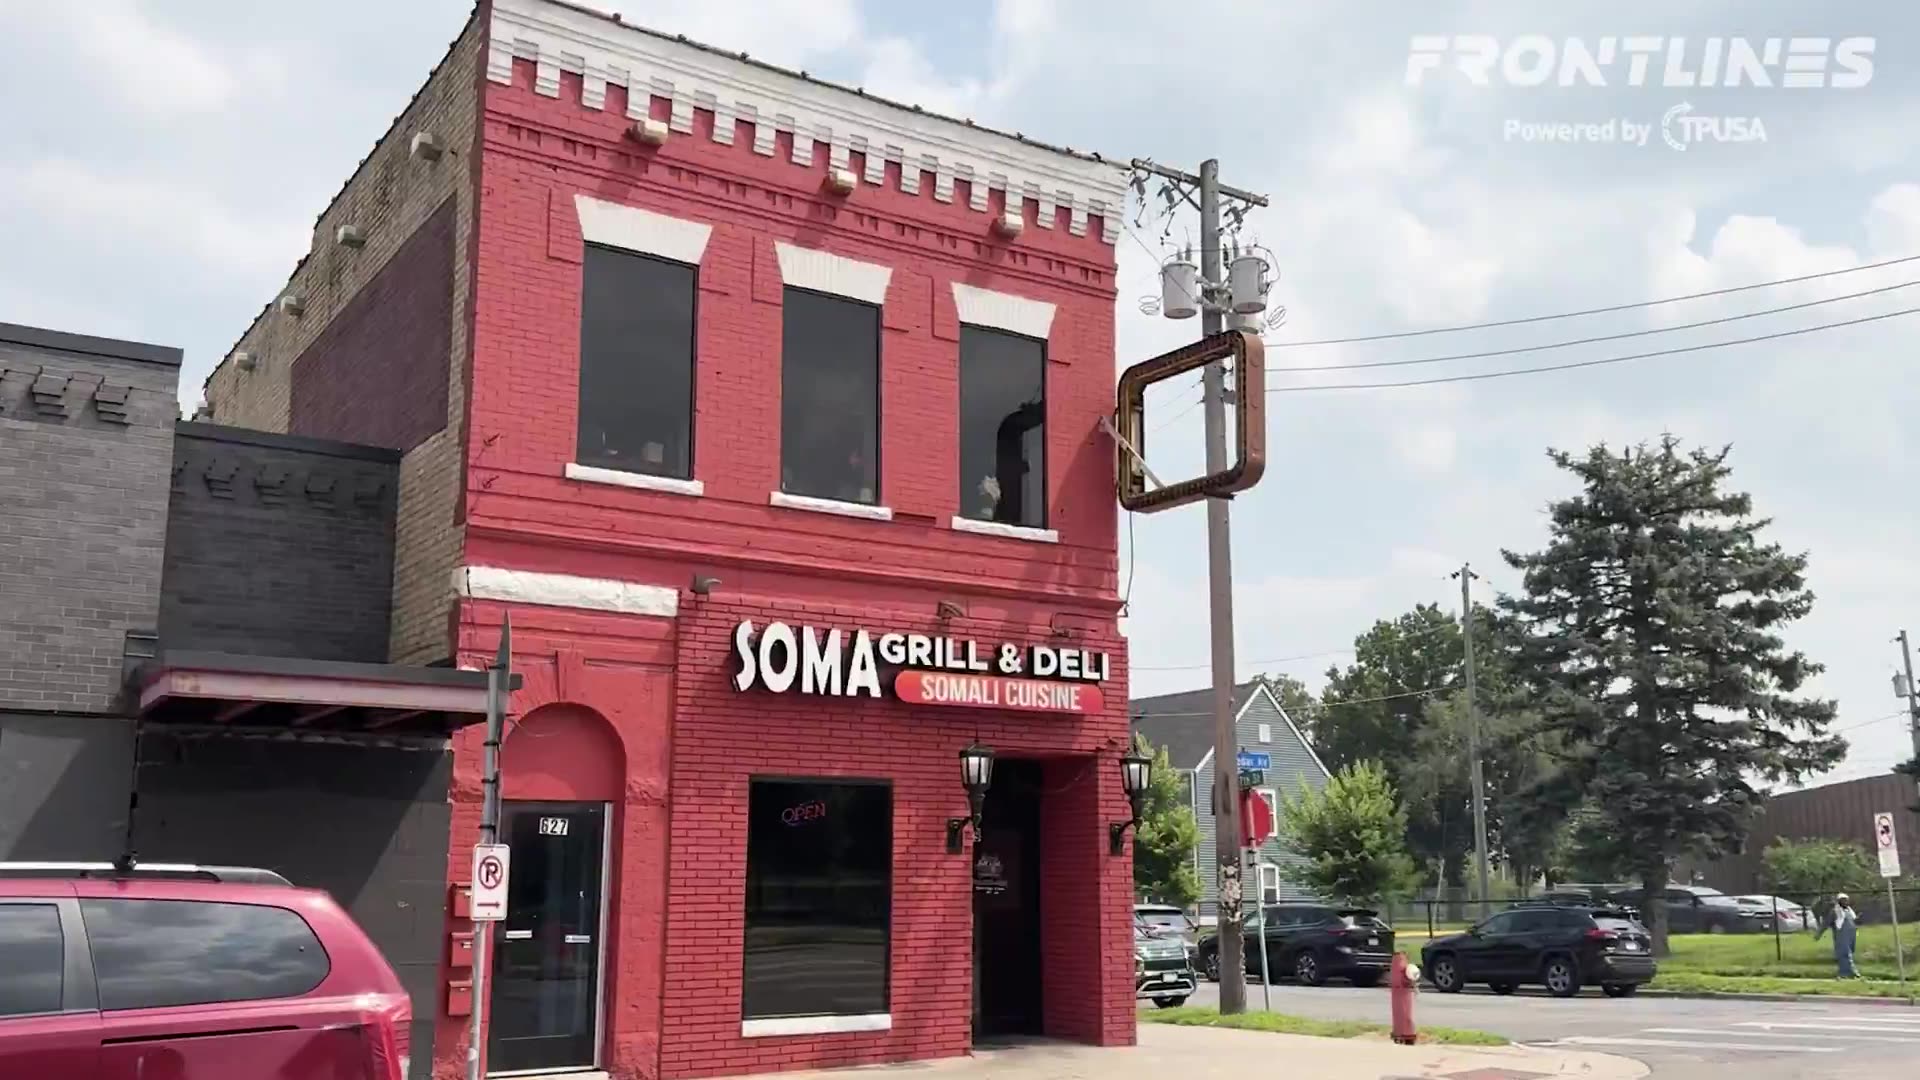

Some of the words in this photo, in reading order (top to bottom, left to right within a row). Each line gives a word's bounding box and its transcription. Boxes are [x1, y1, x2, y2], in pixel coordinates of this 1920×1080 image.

[734, 619, 882, 698] SOMA
[878, 633, 988, 672] GRILL
[998, 642, 1023, 674] &
[1033, 645, 1110, 681] DELI
[921, 676, 999, 706] SOMALI
[1005, 683, 1083, 711] CUISINE
[540, 818, 567, 834] 627
[782, 802, 826, 823] OPEN
